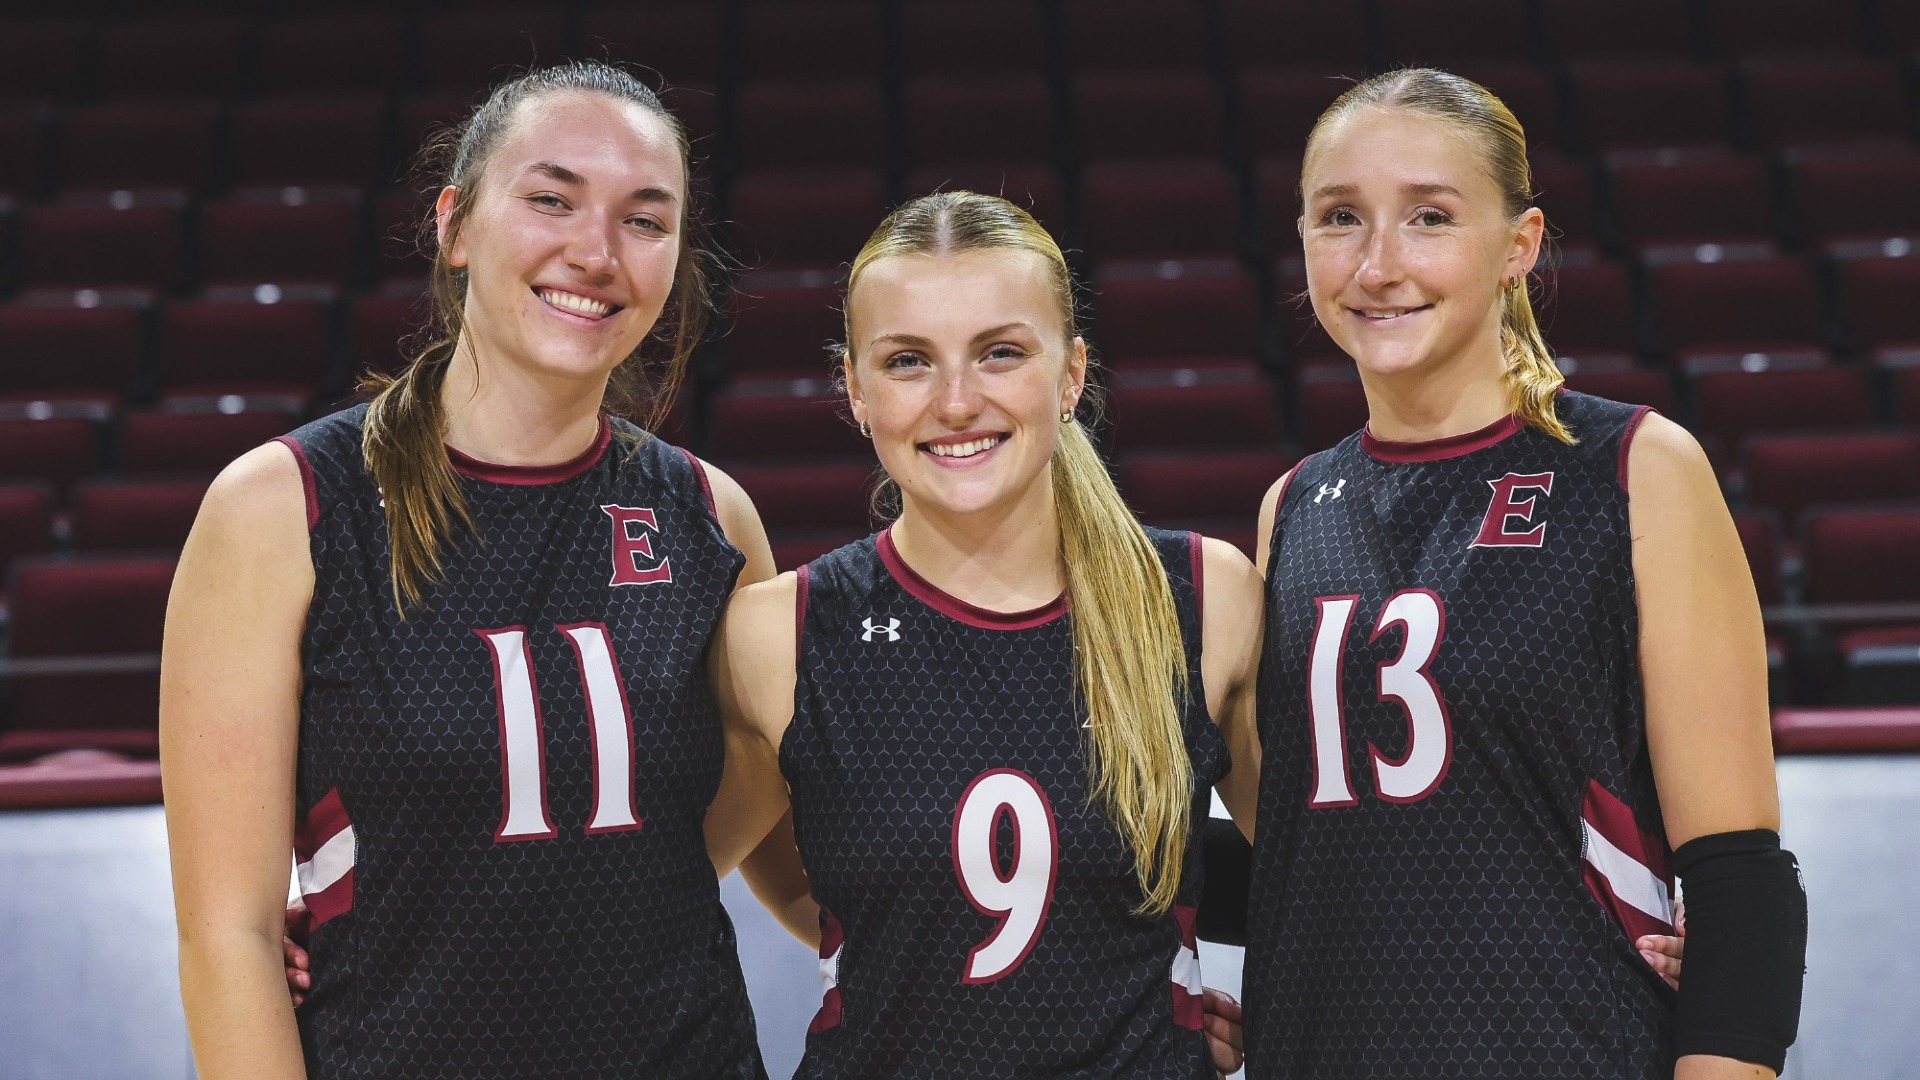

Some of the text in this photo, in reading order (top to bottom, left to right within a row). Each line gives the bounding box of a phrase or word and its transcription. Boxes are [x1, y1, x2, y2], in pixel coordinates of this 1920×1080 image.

[600, 503, 672, 586] E
[1467, 472, 1554, 549] E
[472, 621, 643, 843] 11
[1308, 587, 1453, 809] 13
[952, 767, 1059, 985] 9
